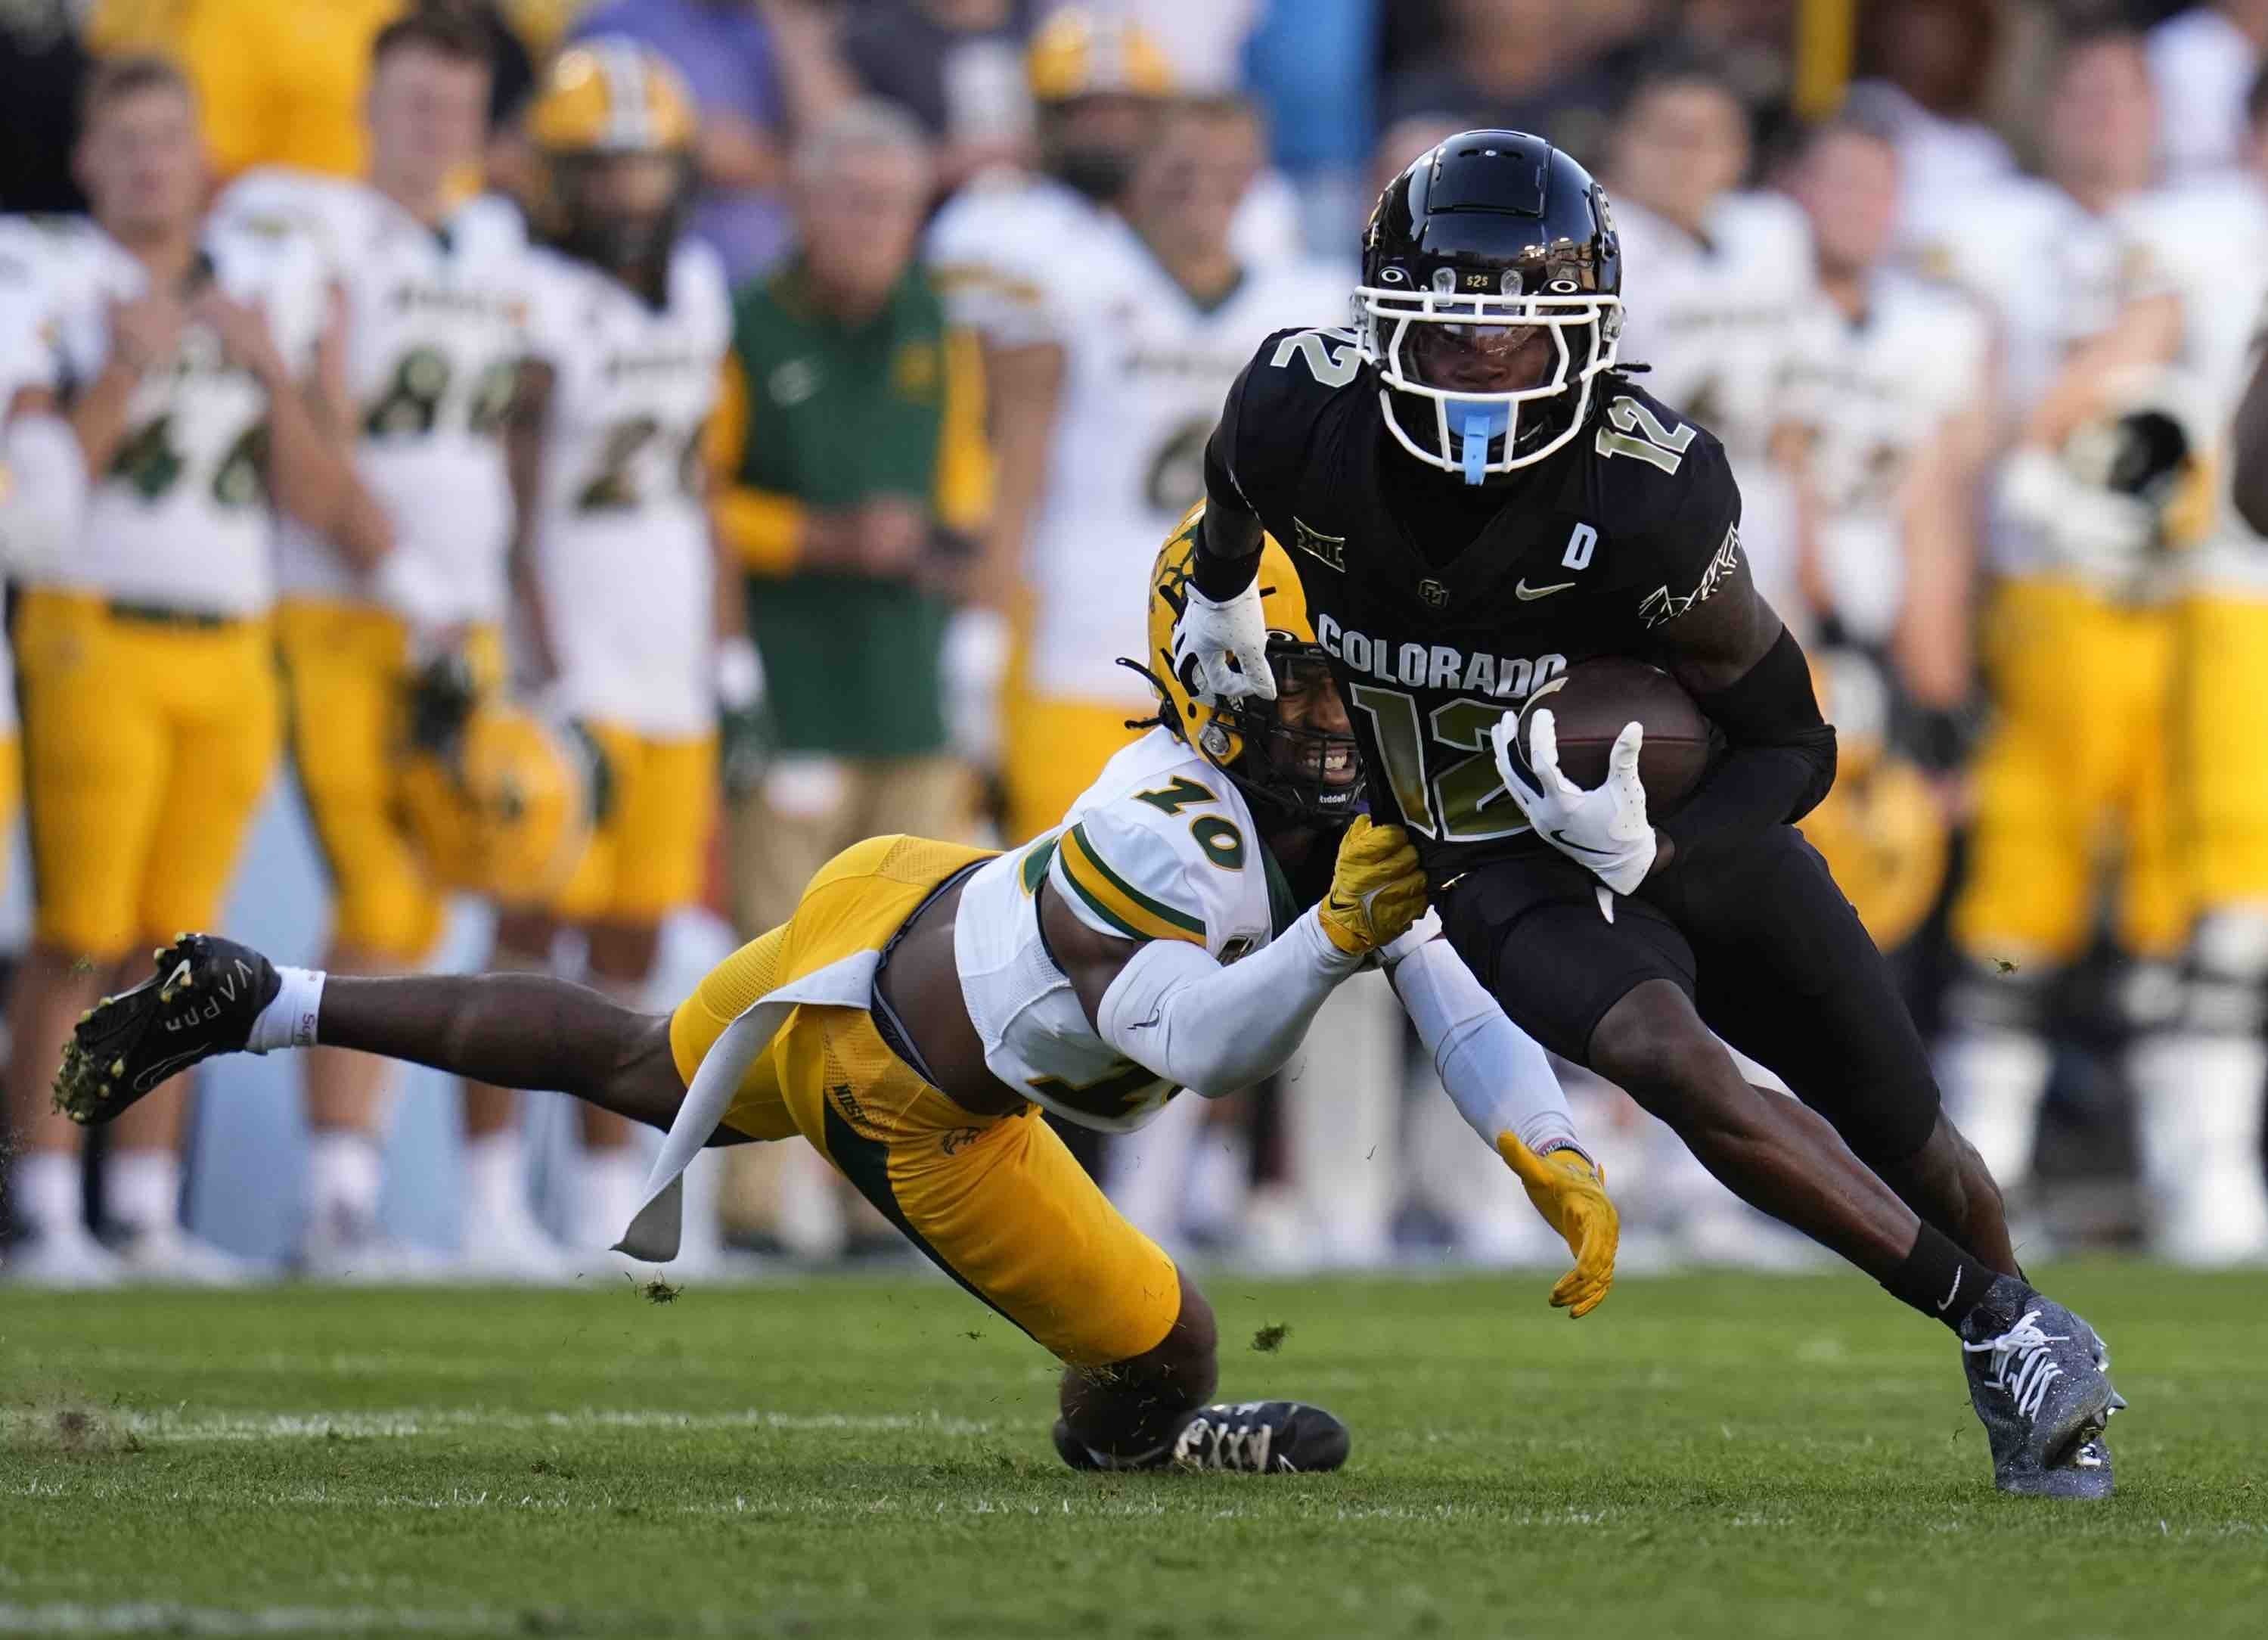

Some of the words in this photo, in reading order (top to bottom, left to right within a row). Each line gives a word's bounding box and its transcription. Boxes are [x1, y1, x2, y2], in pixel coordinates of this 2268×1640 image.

[1596, 396, 1697, 475] 12
[1561, 522, 1598, 570] D
[1318, 613, 1568, 699] COLORADO
[1349, 682, 1534, 842] 12
[1130, 774, 1249, 872] 10
